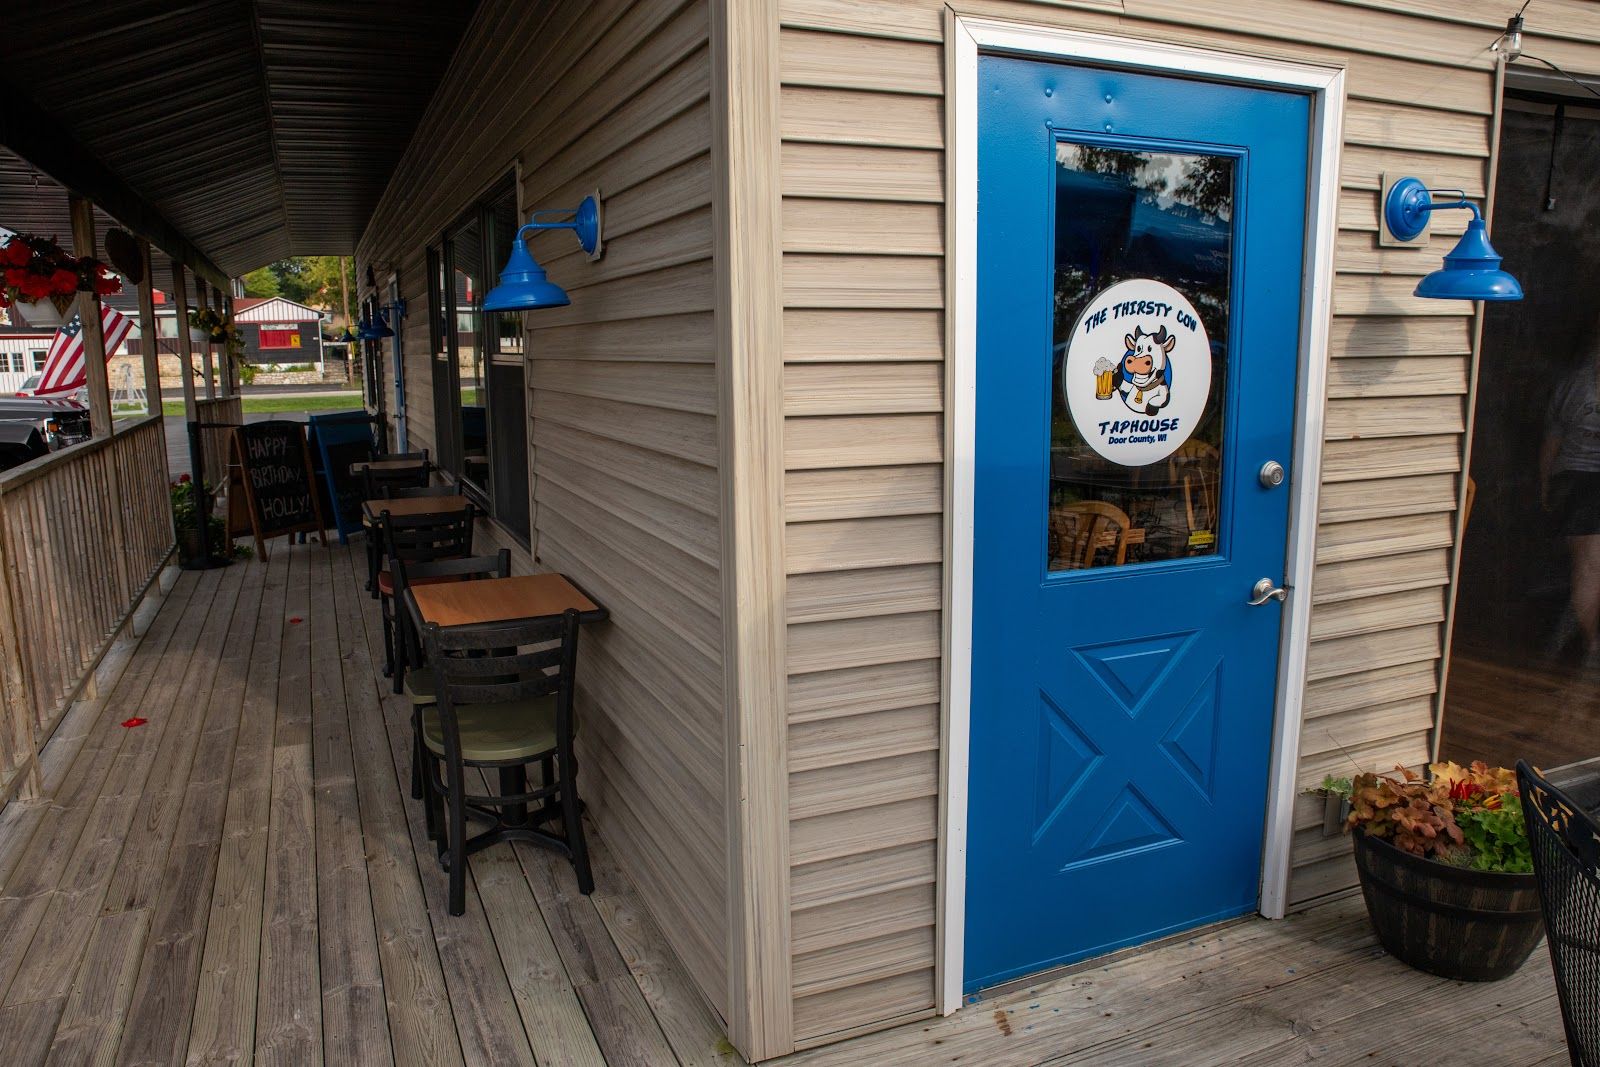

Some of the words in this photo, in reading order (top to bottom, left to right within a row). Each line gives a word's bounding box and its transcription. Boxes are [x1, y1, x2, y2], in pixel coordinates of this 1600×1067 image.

[1084, 308, 1108, 334] THE
[1112, 300, 1172, 319] THIRSTY
[1176, 310, 1197, 332] COW
[1098, 418, 1179, 435] TAPHOUSE
[247, 436, 287, 459] HAPPY
[1108, 435, 1127, 445] Door
[1128, 434, 1156, 444] County,
[1157, 434, 1167, 442] WI
[251, 464, 301, 488] BIRTHDAY
[260, 493, 310, 520] HOLLY!
